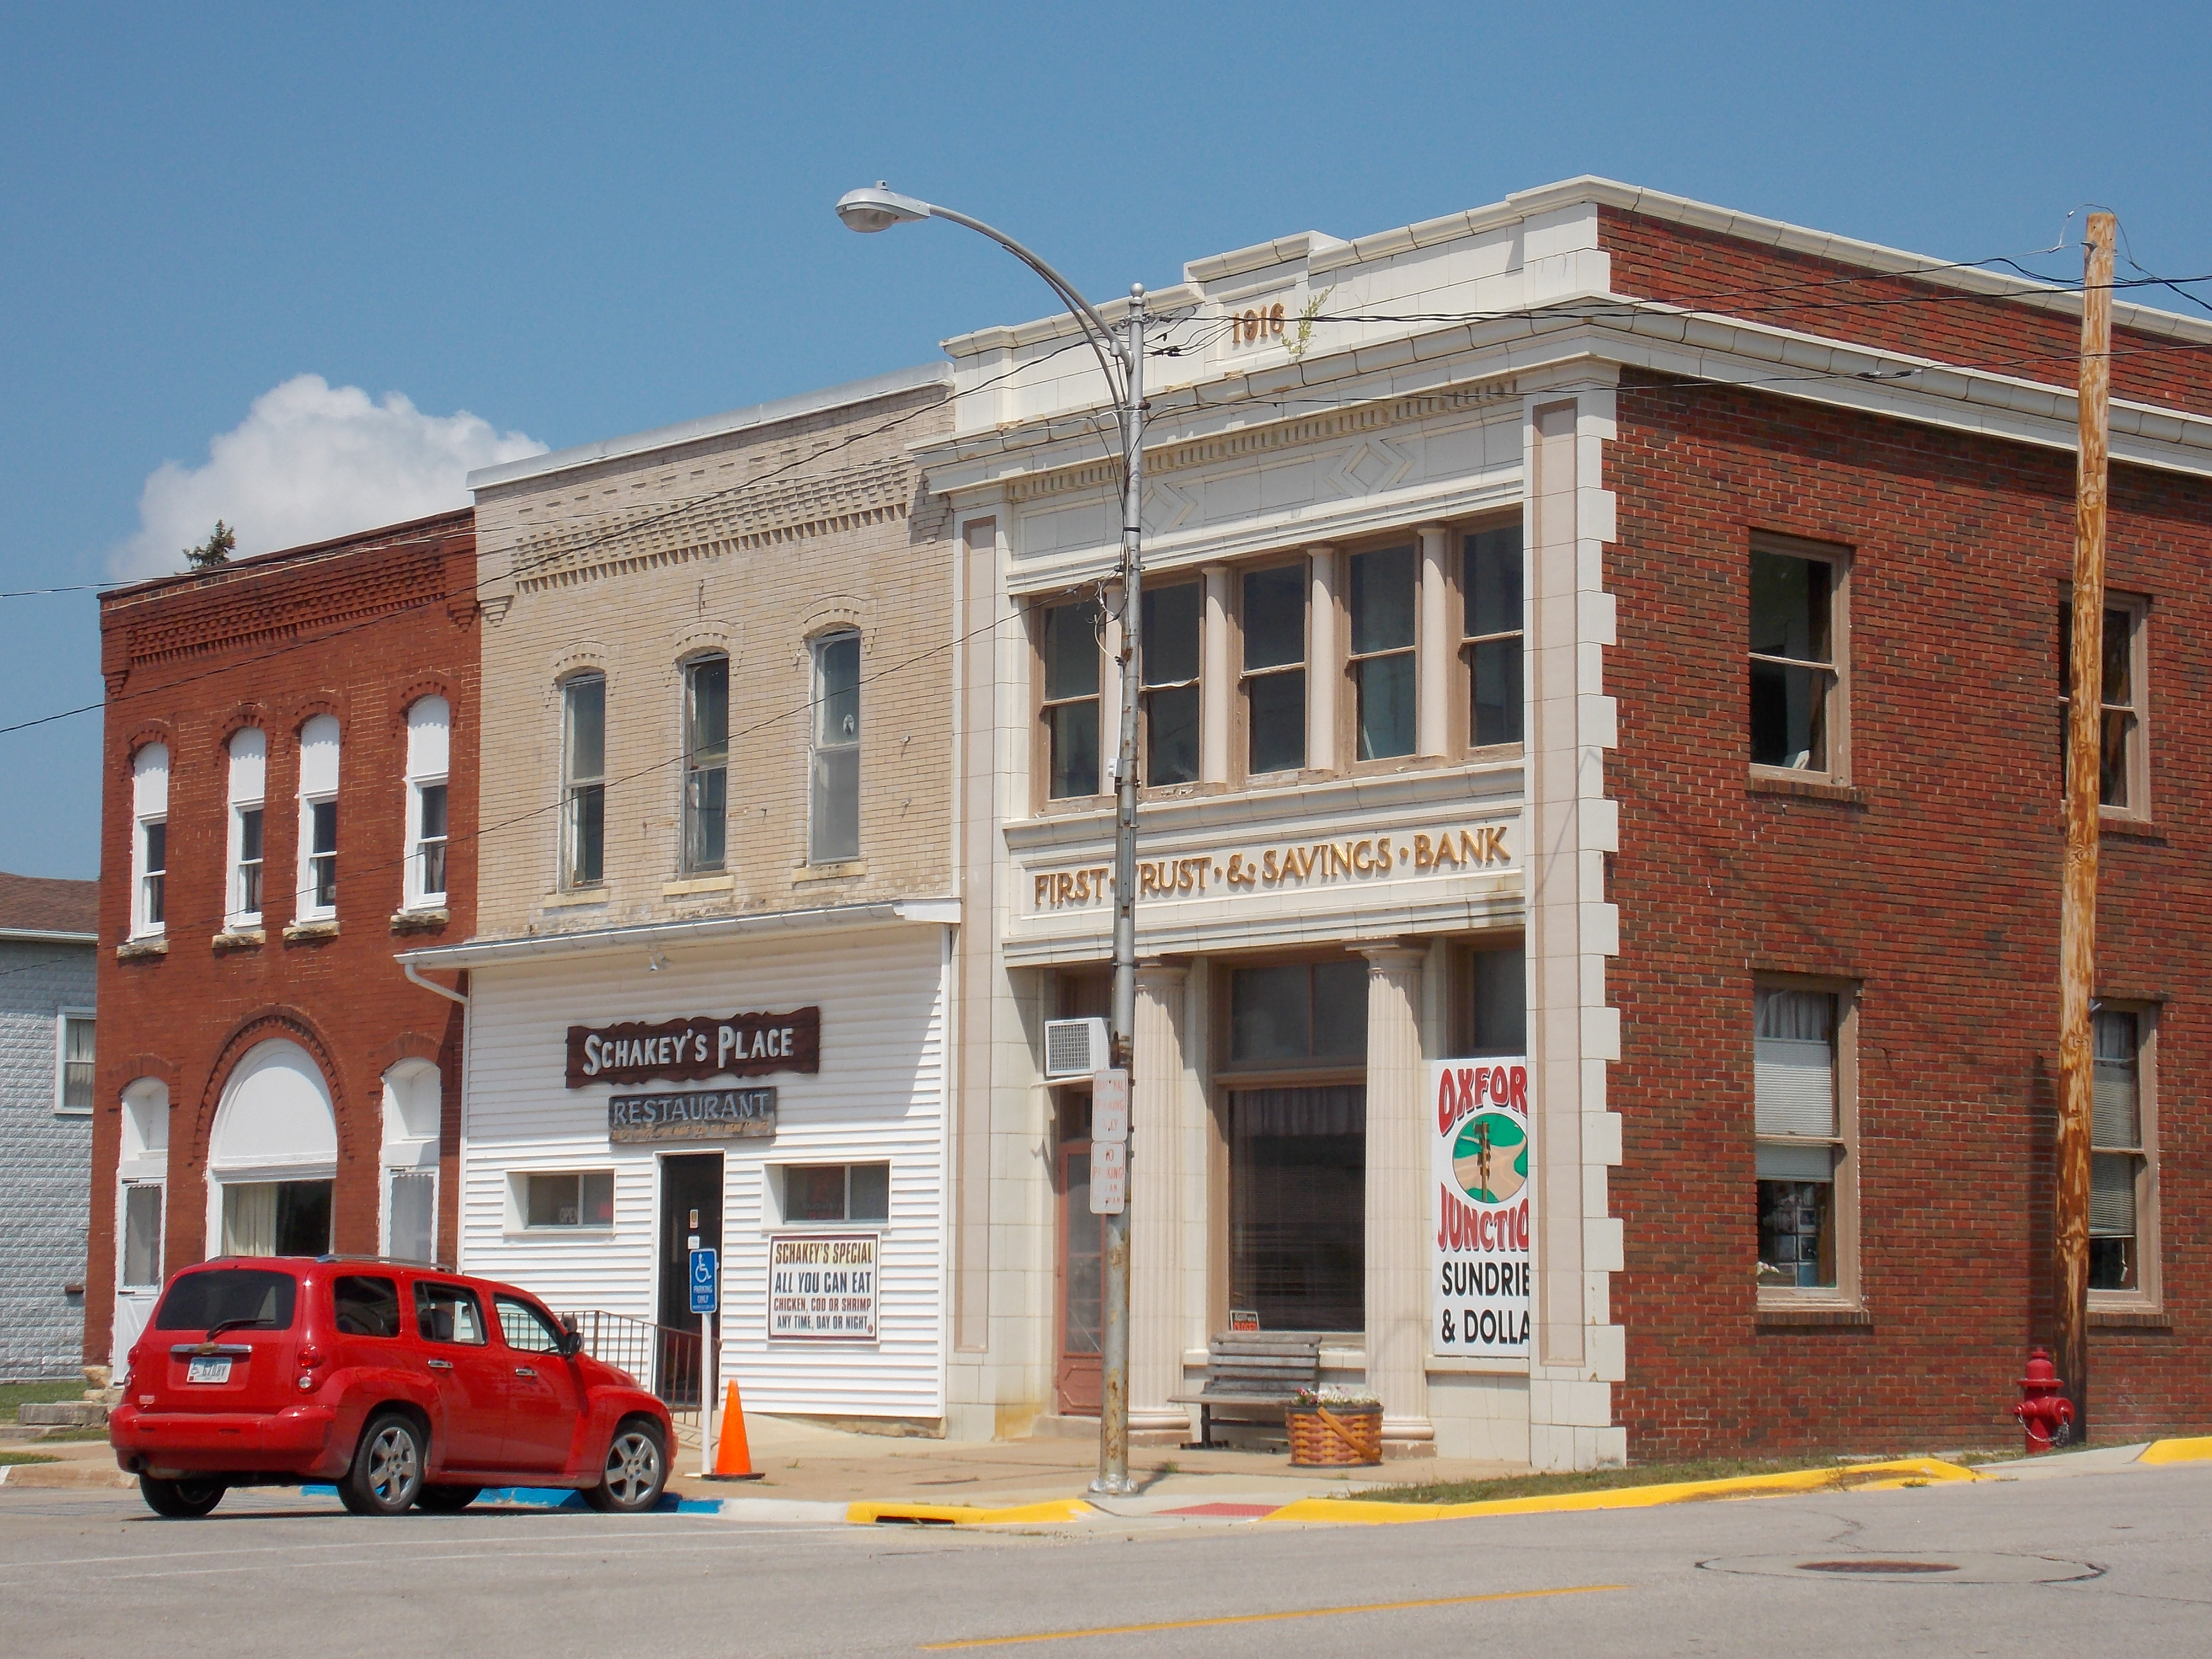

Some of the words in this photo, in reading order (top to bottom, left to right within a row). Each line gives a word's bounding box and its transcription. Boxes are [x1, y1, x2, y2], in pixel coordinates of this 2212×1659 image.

[1231, 303, 1285, 343] 1916
[1135, 857, 1212, 894] RUST
[1414, 826, 1512, 867] BANK
[582, 1028, 708, 1076] SCHAKEY'S
[718, 1025, 794, 1069] PLACE
[613, 1093, 769, 1124] RESTAURANT
[1438, 1065, 1527, 1138] OXFOR
[775, 1242, 830, 1265] SCHAKEY'S
[833, 1242, 873, 1263] SPECIAL
[775, 1272, 793, 1294] ALL
[798, 1272, 819, 1294] YOU
[824, 1272, 847, 1294] CAN
[853, 1272, 872, 1294] EAT
[774, 1298, 808, 1314] CHICKEN,
[811, 1298, 826, 1311] COD
[829, 1298, 839, 1311] OR
[842, 1298, 872, 1311] SHRIMP
[777, 1315, 791, 1329] ANY
[794, 1315, 814, 1332] TIME,
[817, 1315, 830, 1329] DAY
[833, 1315, 843, 1329] OR
[1442, 1309, 1455, 1344] &
[1464, 1309, 1529, 1344] DOLLA
